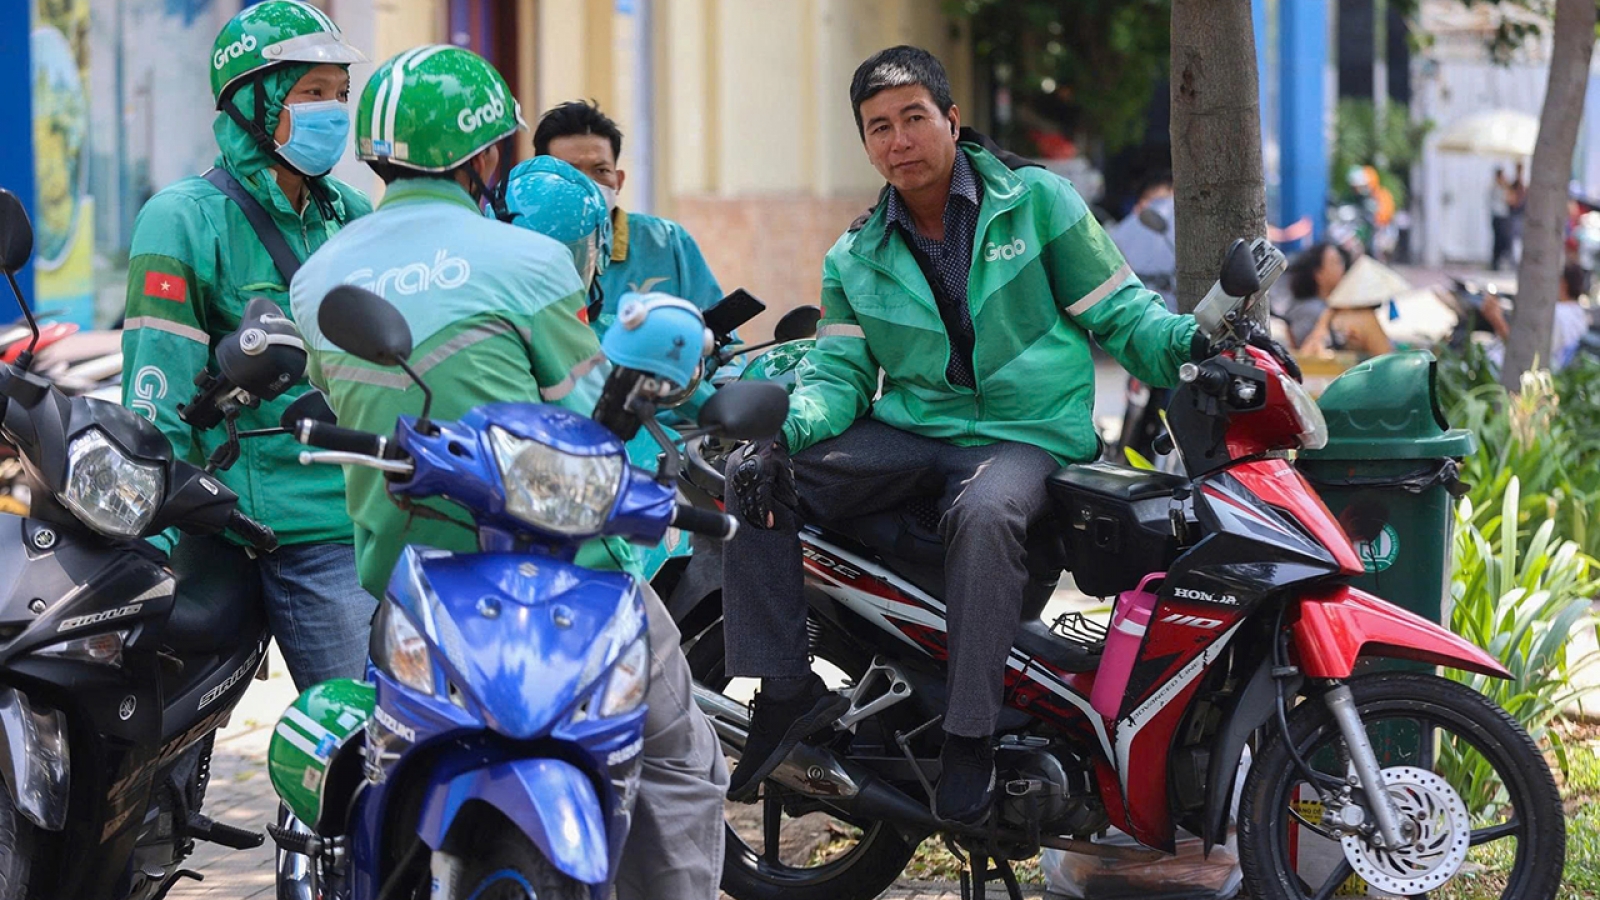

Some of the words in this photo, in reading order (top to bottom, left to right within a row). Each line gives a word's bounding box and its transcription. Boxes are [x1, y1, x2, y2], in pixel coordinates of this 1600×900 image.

[214, 33, 257, 70] Grab
[457, 93, 505, 133] Grab
[984, 236, 1026, 262] Grab
[57, 603, 143, 633] SIRIUS
[1160, 613, 1224, 629] 110
[197, 648, 257, 711] SIRIUS
[374, 704, 415, 744] SUZUKI
